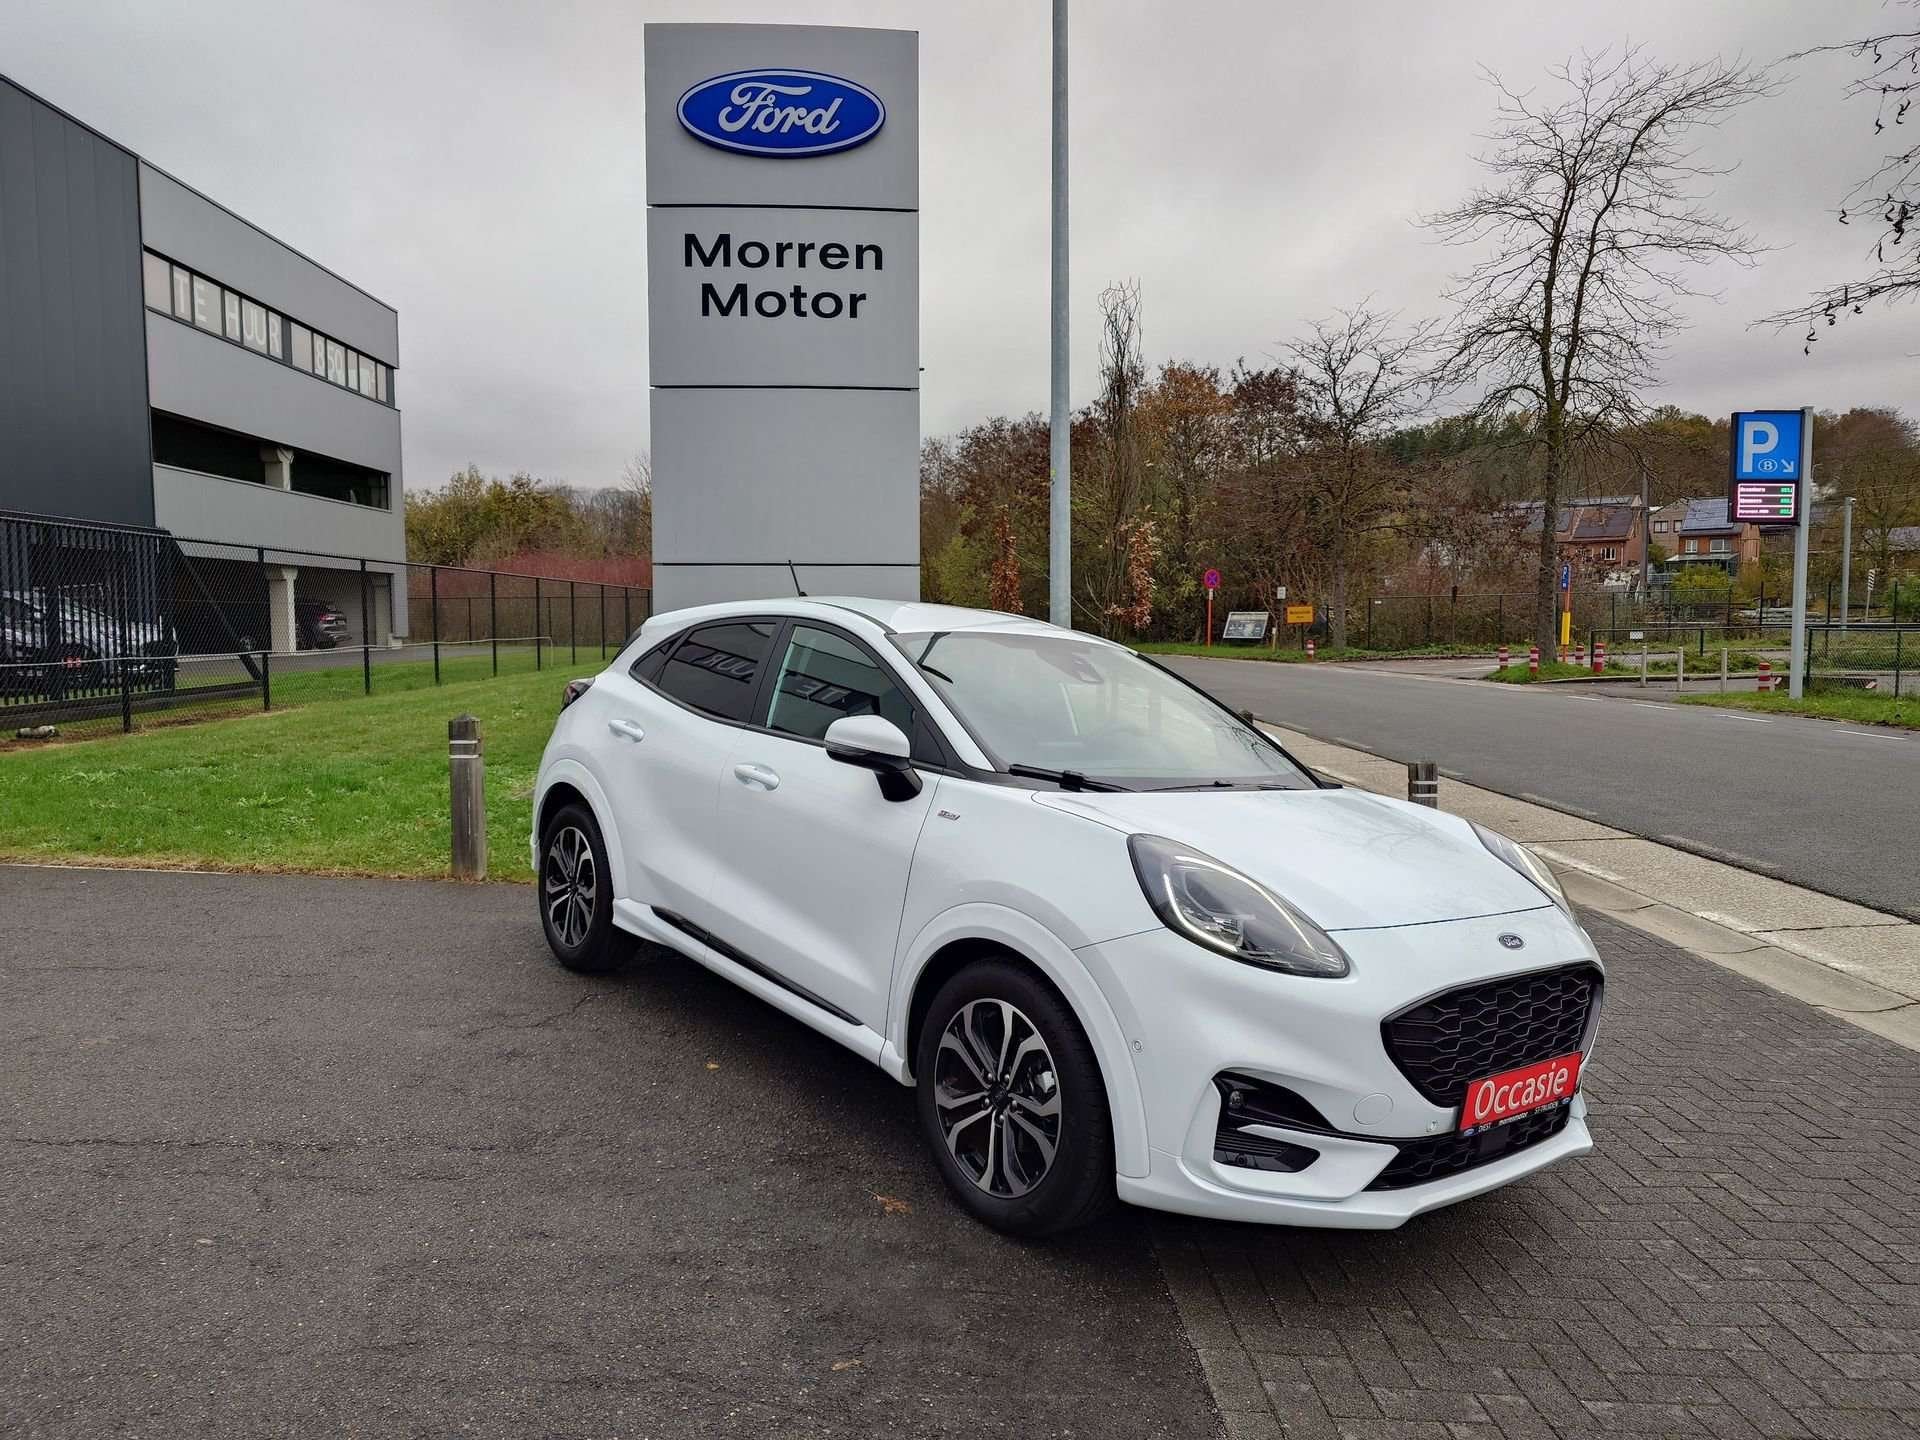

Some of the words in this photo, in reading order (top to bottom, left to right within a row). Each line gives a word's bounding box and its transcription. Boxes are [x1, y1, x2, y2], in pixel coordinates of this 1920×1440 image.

[718, 82, 843, 135] Ford
[684, 233, 883, 270] Morren
[174, 271, 207, 322] TE
[225, 297, 280, 353] HUUR
[701, 283, 867, 319] Motor
[1743, 421, 1779, 473] P
[1474, 1062, 1569, 1120] Occasie
